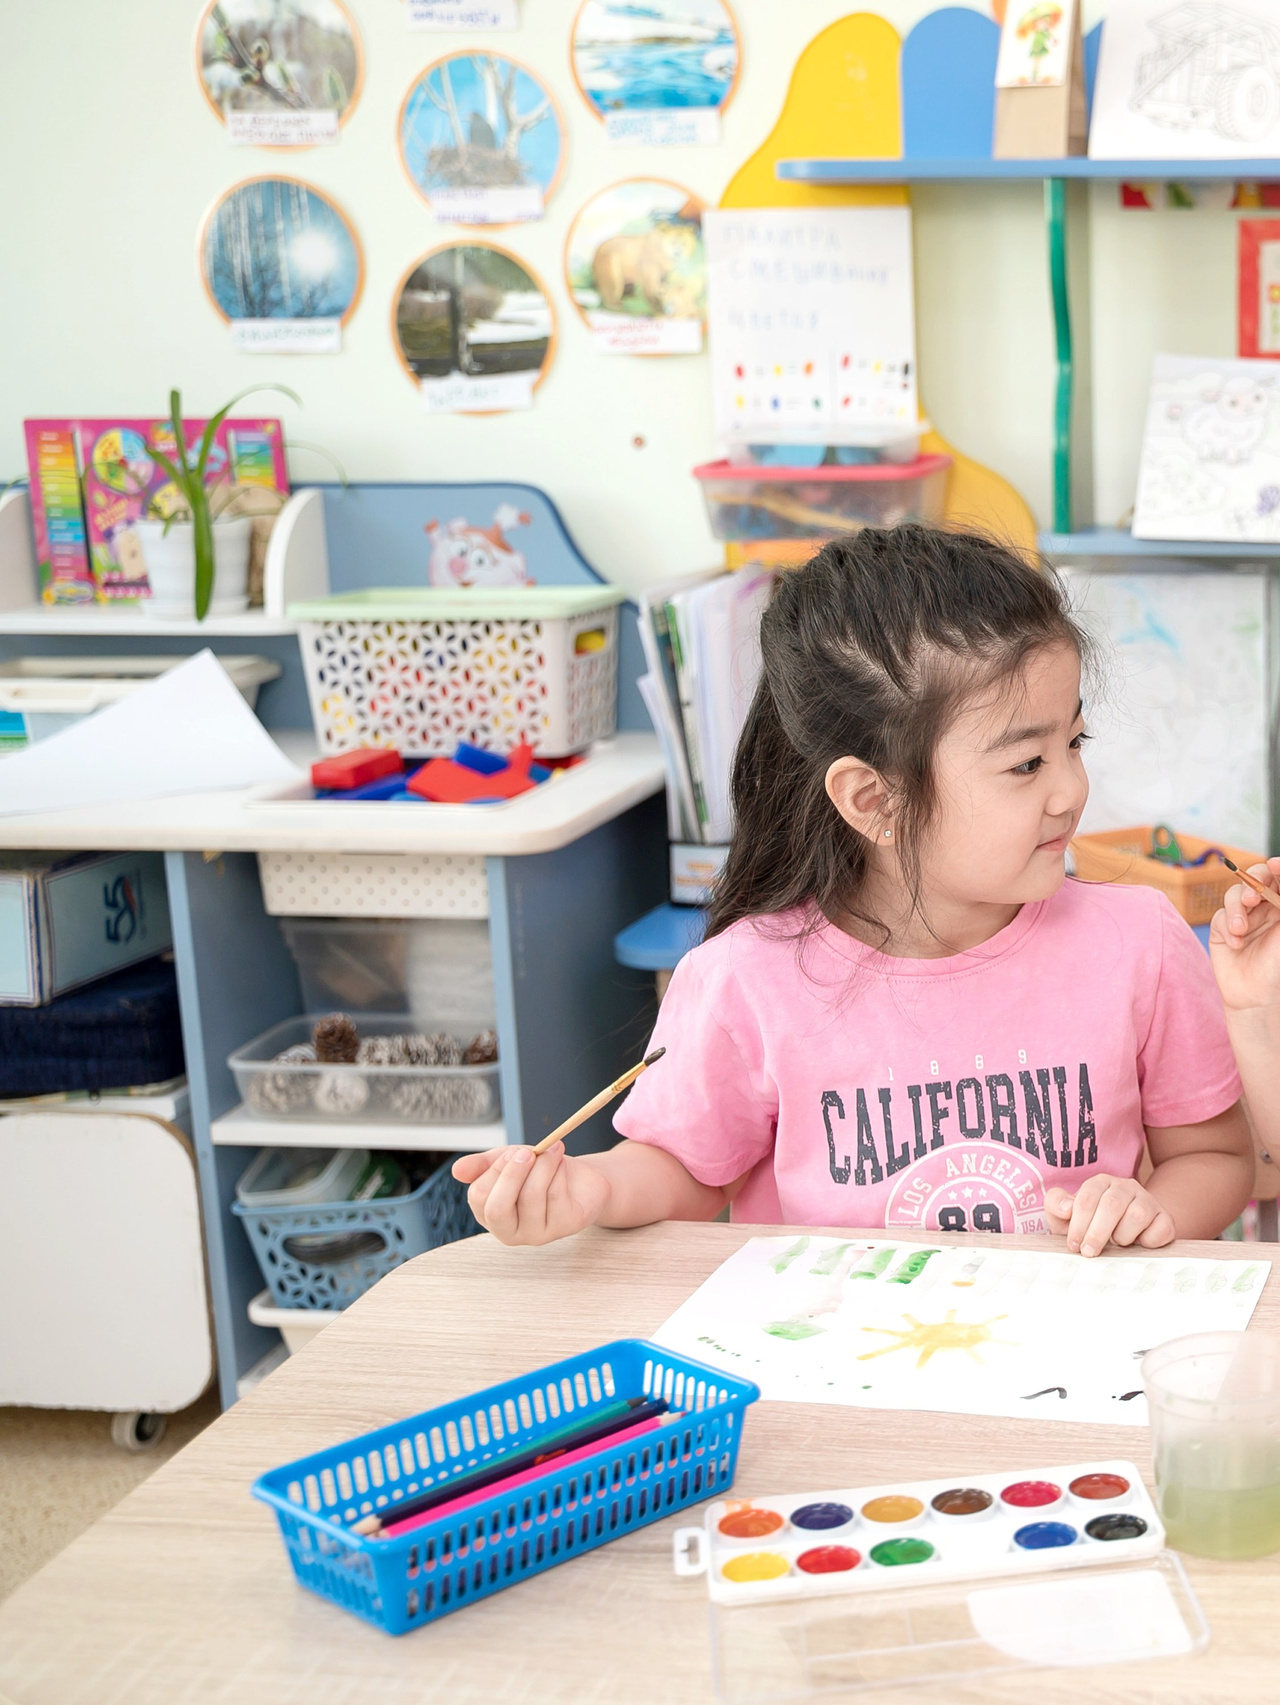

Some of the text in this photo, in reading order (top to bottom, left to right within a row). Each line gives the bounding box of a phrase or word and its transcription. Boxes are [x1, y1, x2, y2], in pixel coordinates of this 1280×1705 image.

[820, 1063, 1098, 1185] CALIFORNIA
[898, 1153, 1037, 1218] LOS ANGELES
[1021, 1218, 1044, 1234] USA
